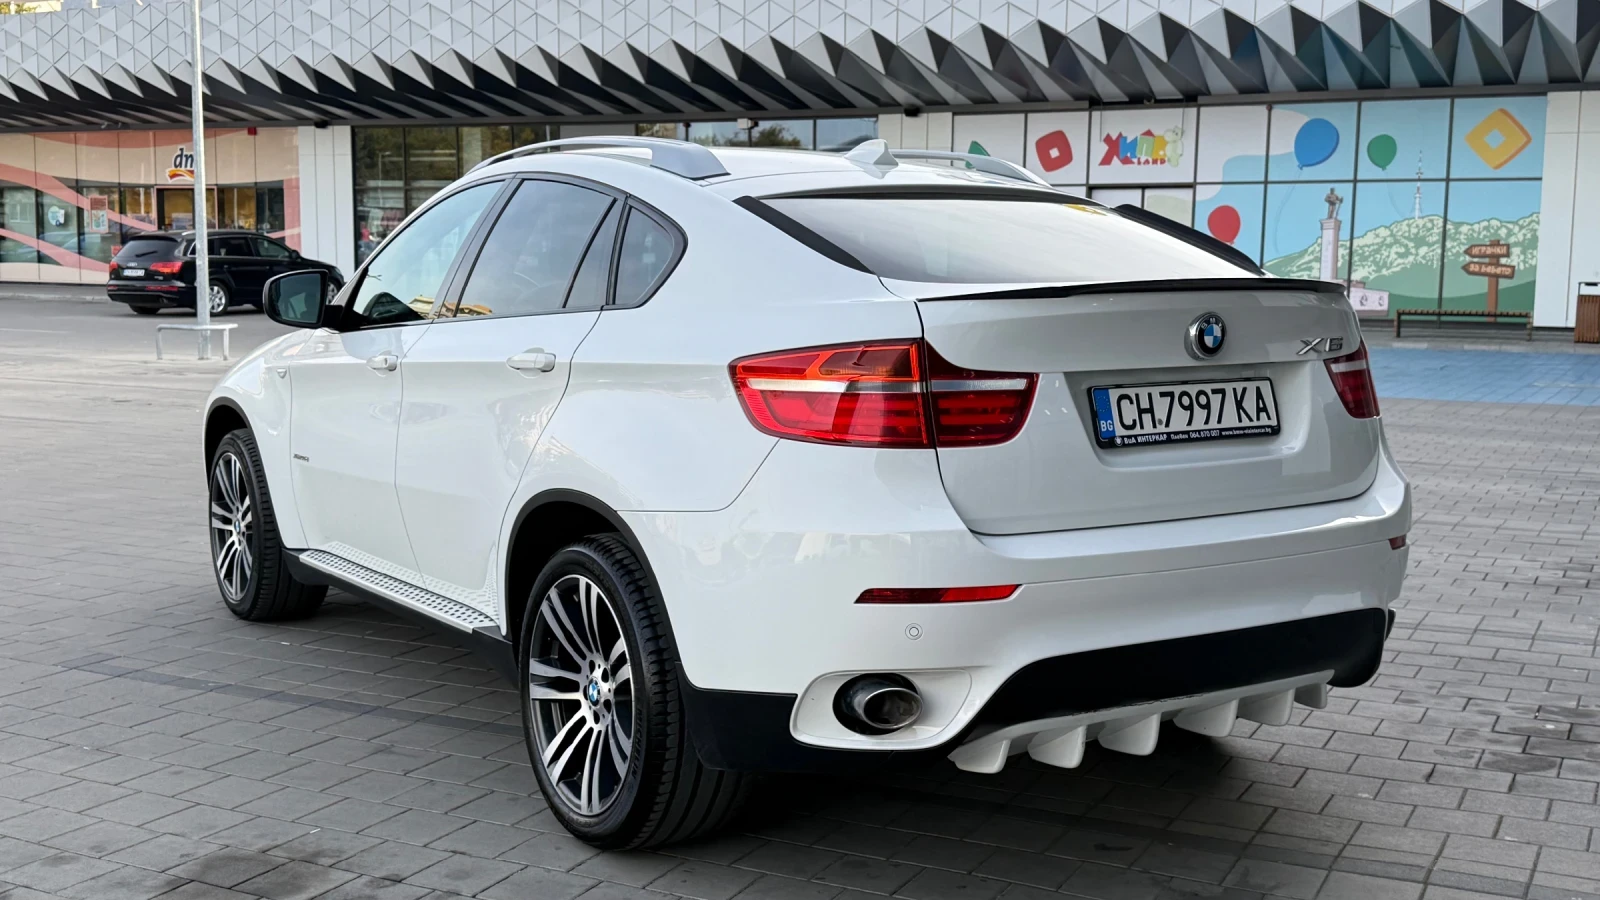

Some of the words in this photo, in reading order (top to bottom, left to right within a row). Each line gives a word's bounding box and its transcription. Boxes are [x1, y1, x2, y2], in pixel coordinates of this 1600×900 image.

[1137, 157, 1167, 166] LAND
[1296, 337, 1344, 355] X6
[1100, 420, 1114, 432] BG
[1137, 434, 1167, 442] ИНТЕРКАР
[630, 708, 643, 780] MICHELIN
